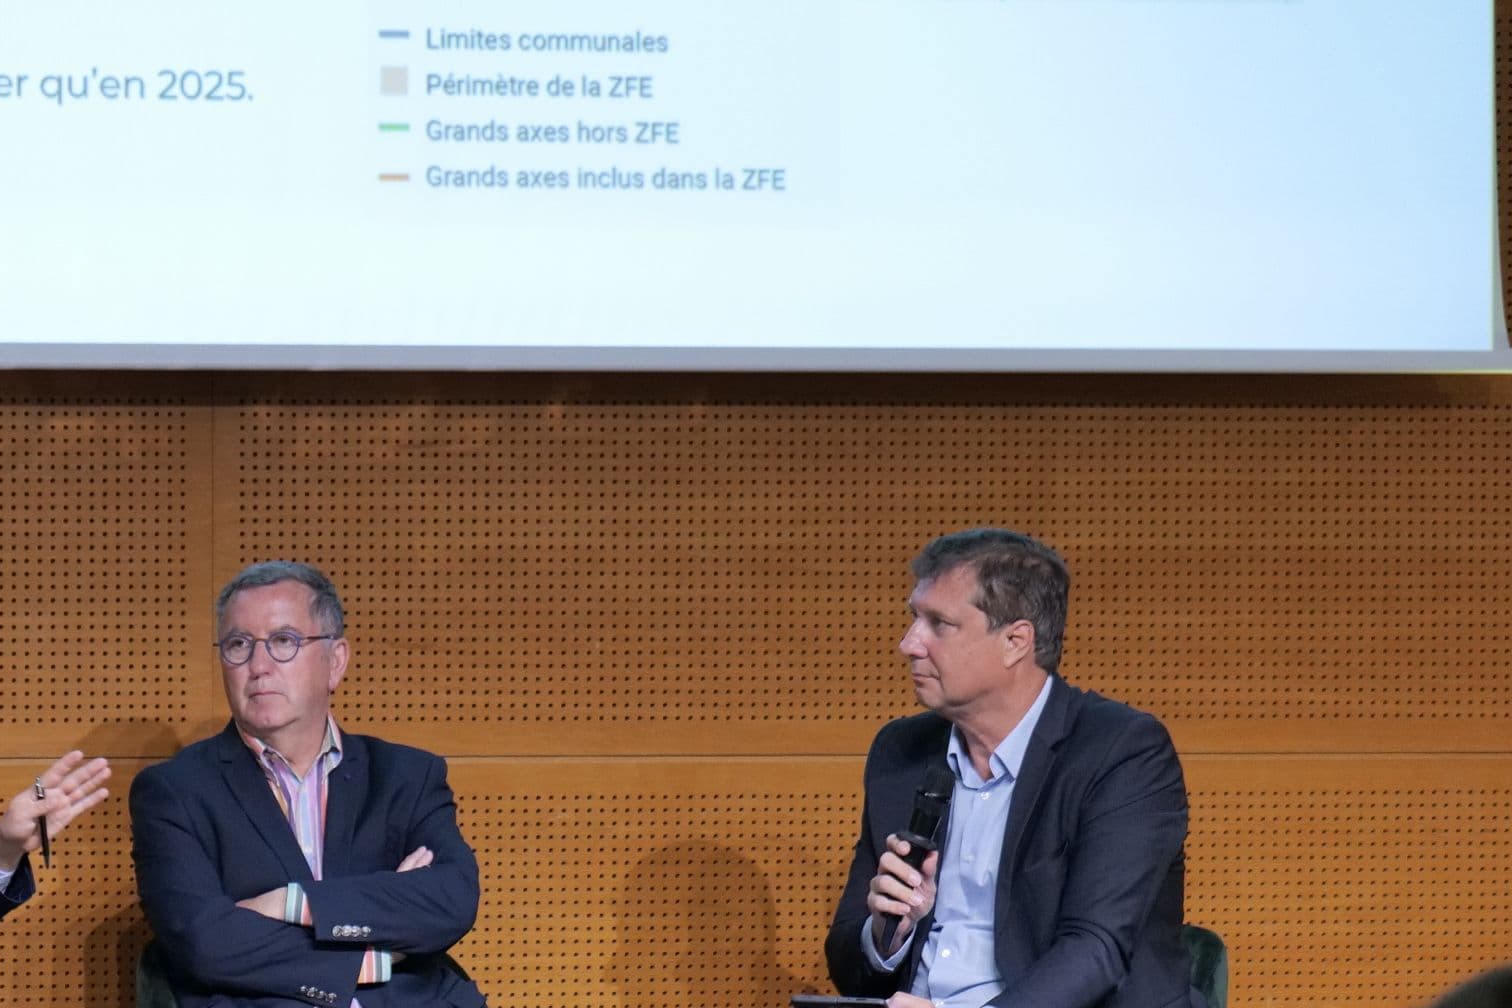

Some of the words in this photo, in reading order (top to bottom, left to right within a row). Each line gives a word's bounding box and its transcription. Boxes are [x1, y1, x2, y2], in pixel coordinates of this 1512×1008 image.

[425, 27, 513, 52] Limites
[517, 30, 670, 54] communales
[39, 66, 145, 105] qu'en
[157, 69, 255, 102] 2025.
[425, 72, 540, 97] Périmètre
[545, 74, 576, 98] de
[581, 74, 602, 98] la
[608, 75, 653, 99] ZFE
[425, 119, 510, 143] Grands
[515, 124, 571, 144] axes
[576, 119, 629, 144] hors
[634, 121, 680, 145] ZFE
[425, 164, 510, 189] Grands
[515, 170, 571, 189] axes
[577, 166, 645, 190] inclus
[650, 167, 708, 191] dans
[714, 167, 736, 191] la
[741, 168, 786, 191] ZFE
